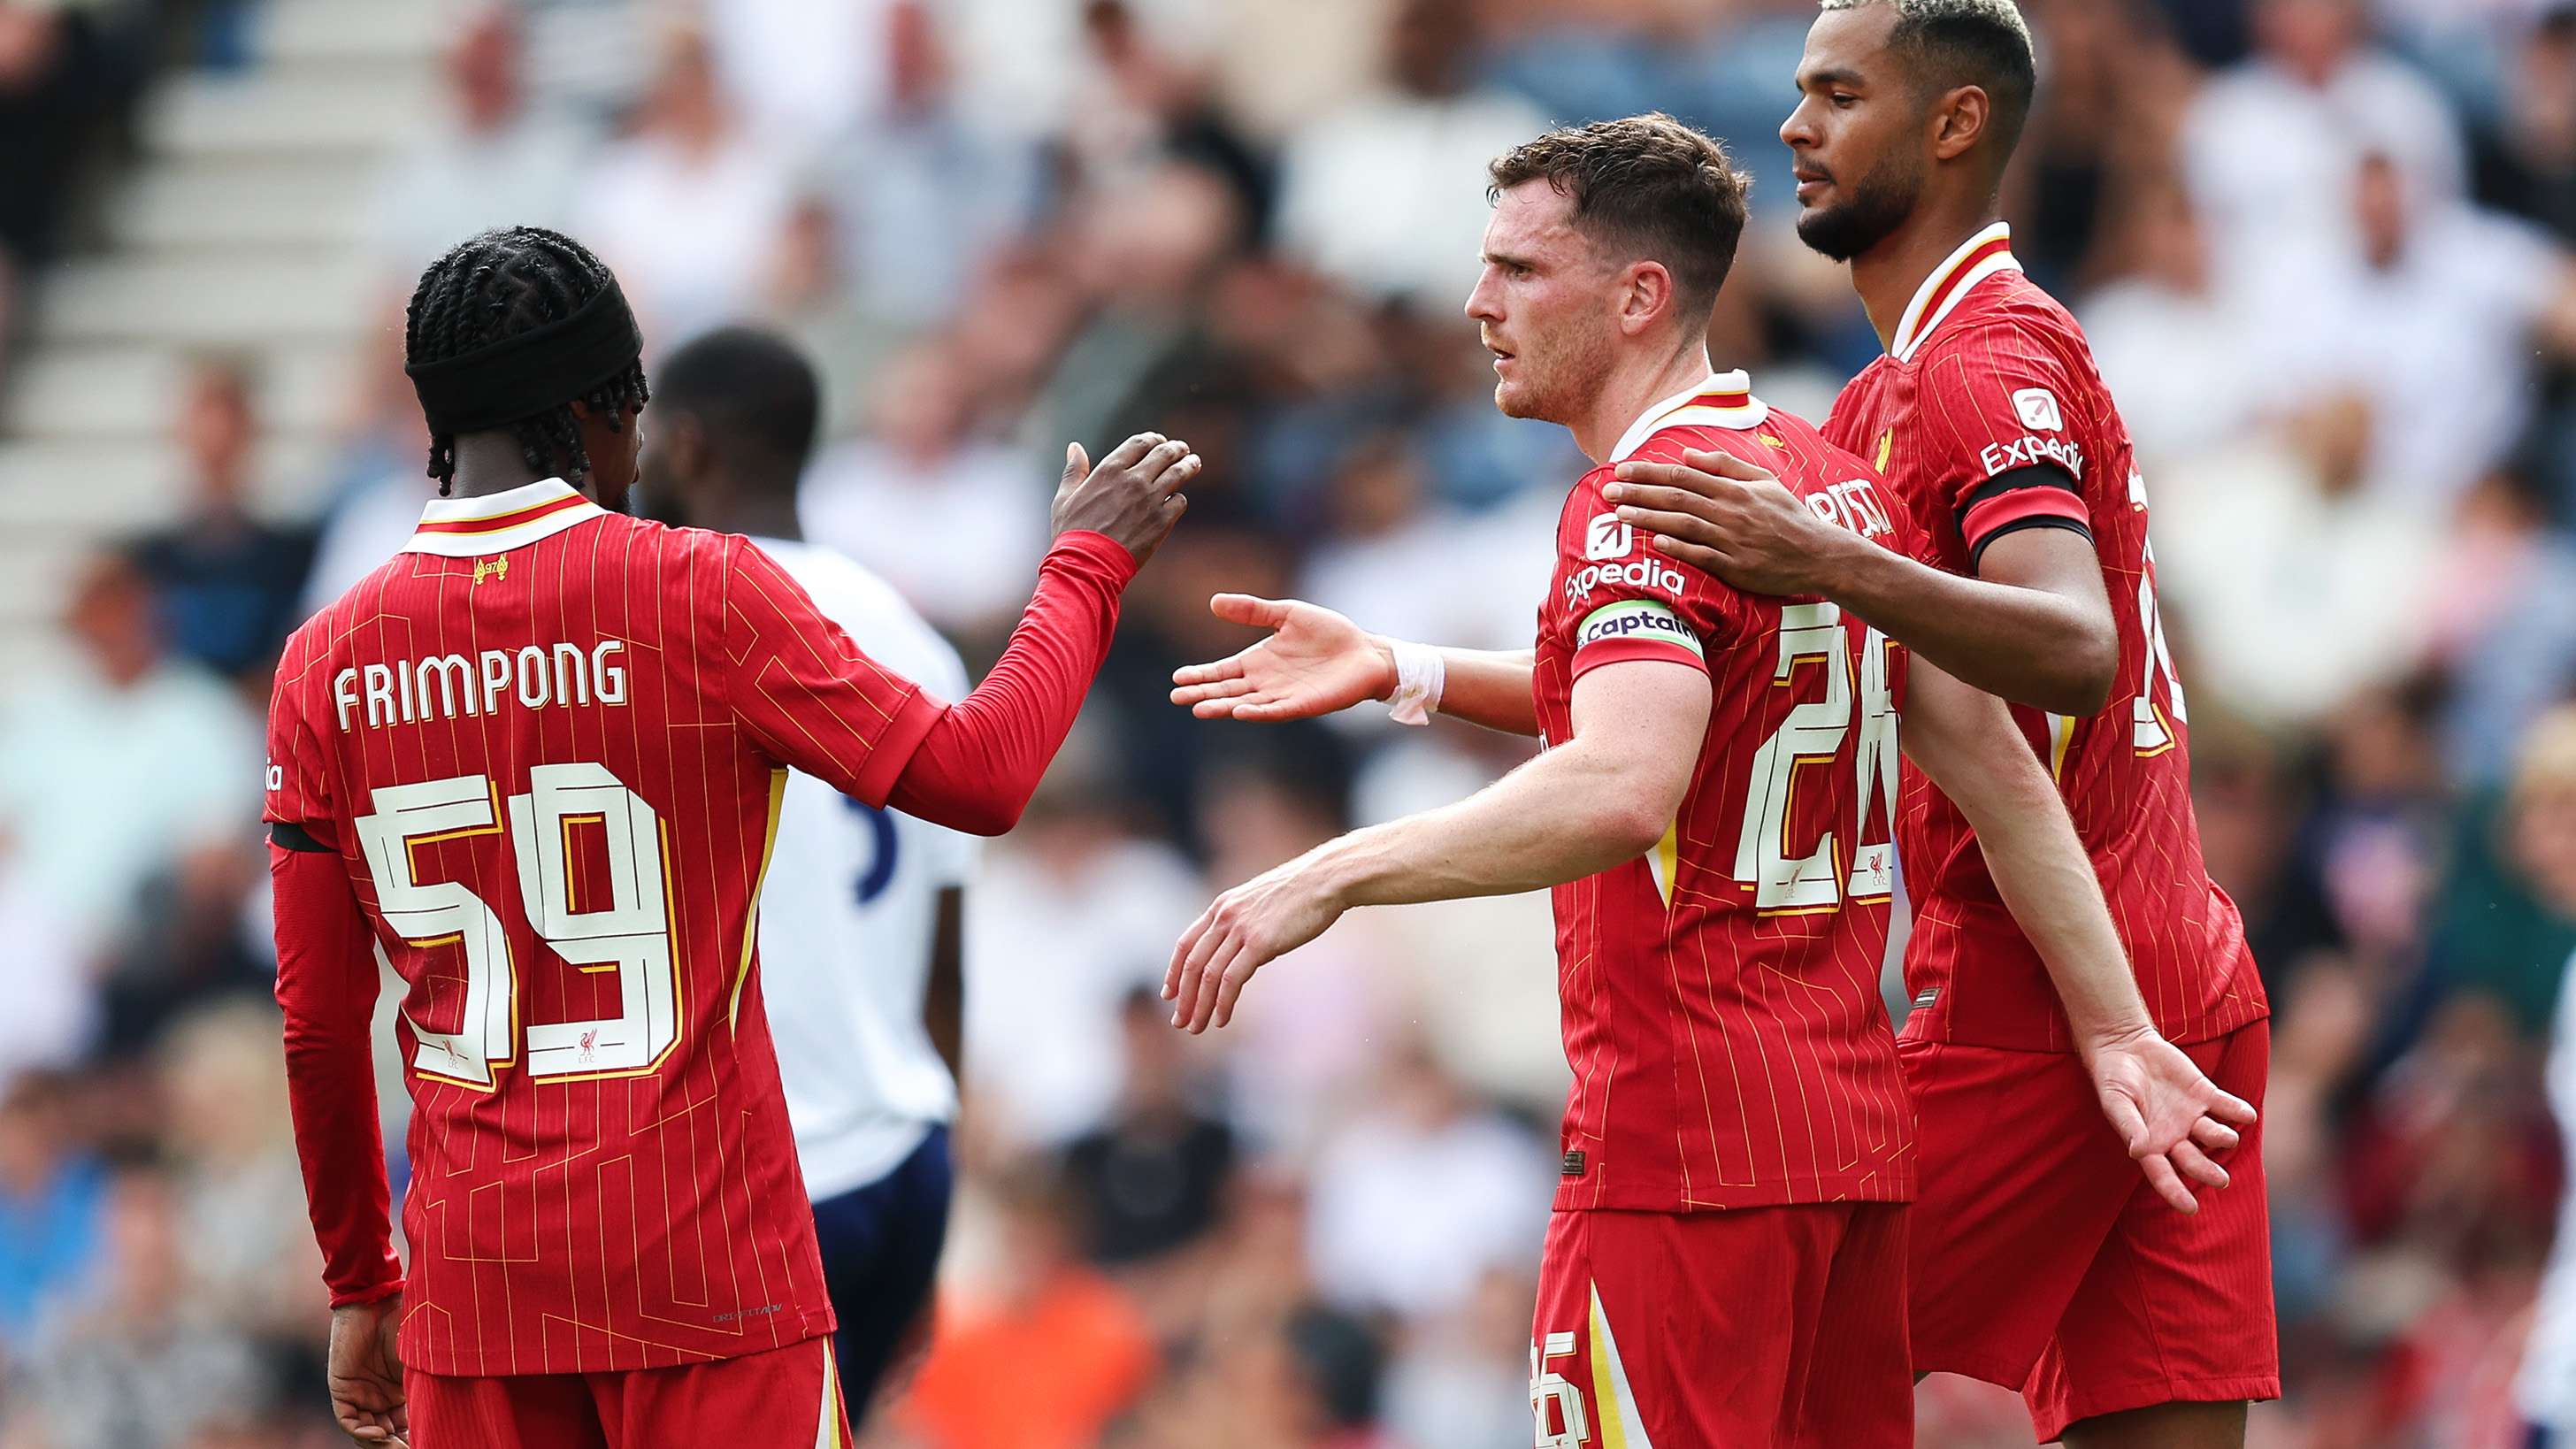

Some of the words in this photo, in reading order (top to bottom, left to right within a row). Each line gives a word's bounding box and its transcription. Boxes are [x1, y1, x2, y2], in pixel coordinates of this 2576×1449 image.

[485, 561, 498, 573] 97
[1565, 557, 1686, 612] Expedia
[334, 640, 627, 733] FRIMPONG
[354, 762, 684, 1093] 59
